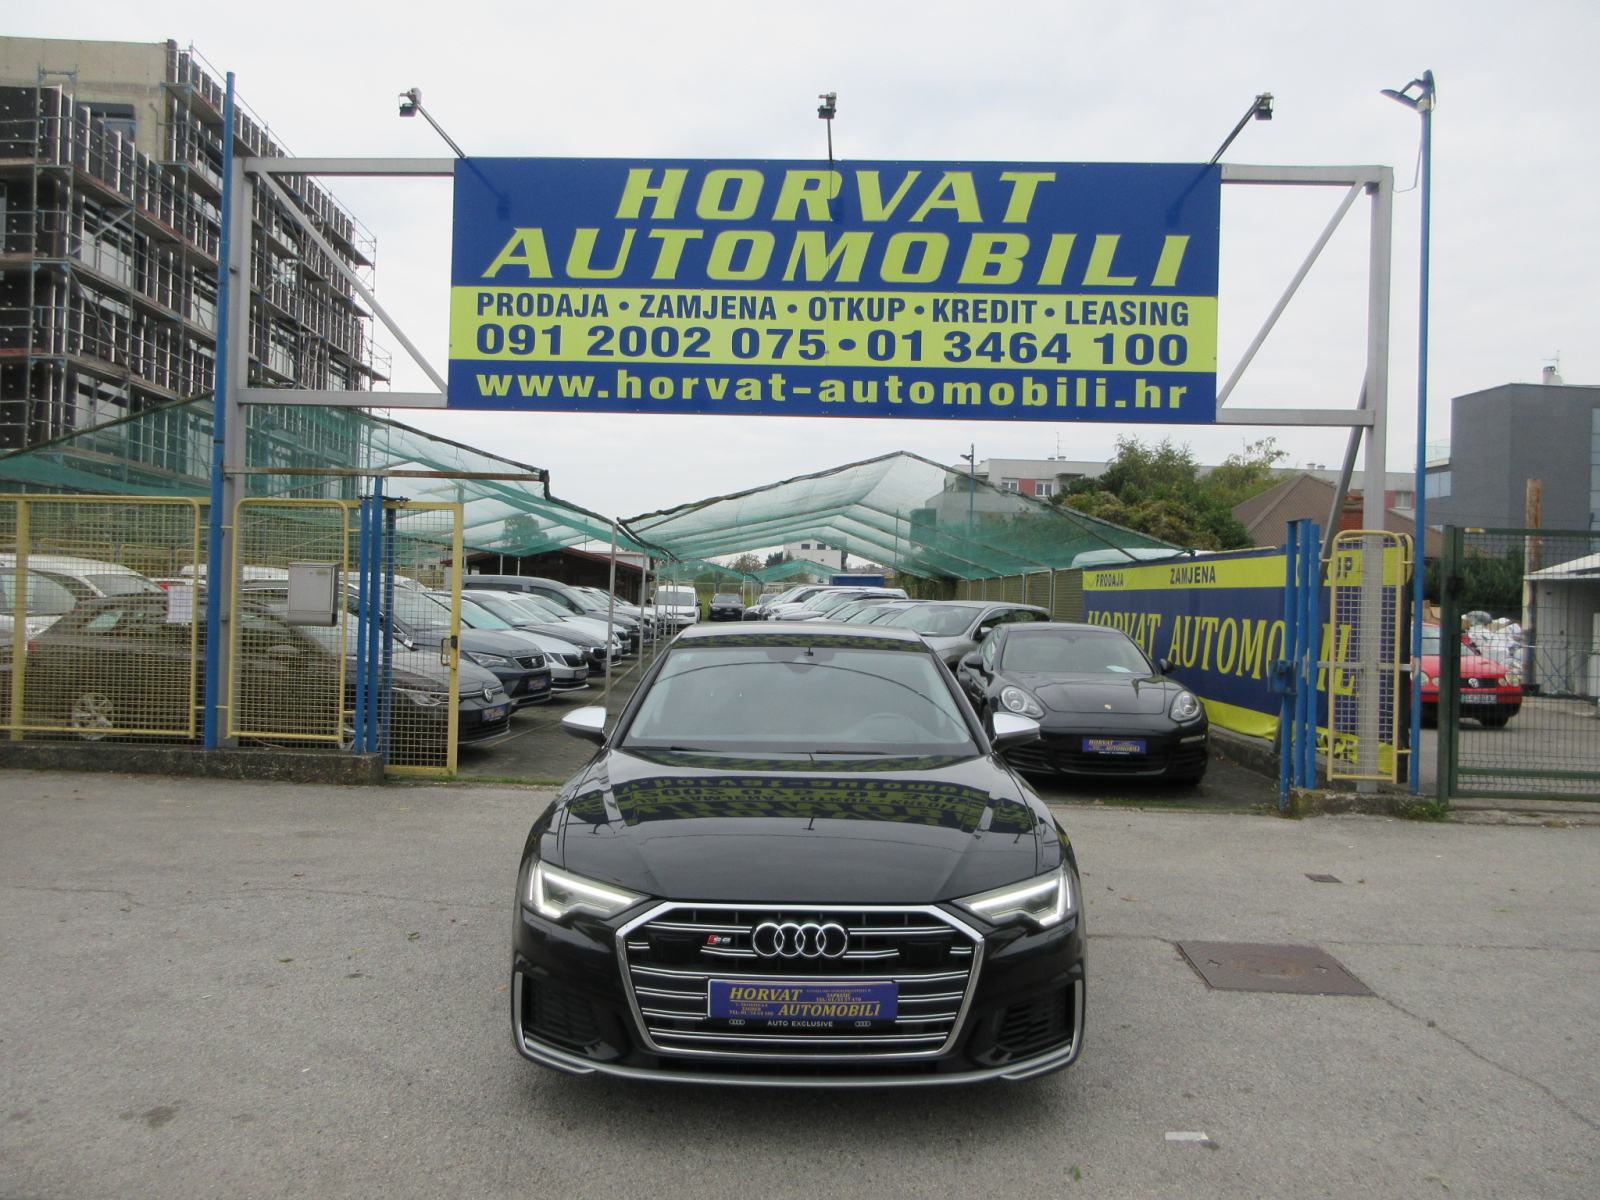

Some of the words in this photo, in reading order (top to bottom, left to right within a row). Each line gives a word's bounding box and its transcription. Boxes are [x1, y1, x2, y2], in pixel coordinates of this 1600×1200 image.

[615, 168, 1056, 223] HORVAT
[481, 228, 1190, 286] AUTOMOBILI
[477, 292, 609, 317] PRODAJA
[639, 294, 777, 320] ZAMJENA
[808, 296, 906, 321] OTKUP
[932, 298, 1037, 323] KREDIT
[1065, 300, 1189, 326] LEASING
[476, 323, 562, 355] 091
[587, 325, 711, 358] 2002
[731, 327, 827, 360] 075
[867, 329, 923, 362] 01
[943, 331, 1071, 364] 3464
[1094, 333, 1188, 366] 100
[476, 369, 1187, 408] www.horvat-automobili.hr
[1095, 573, 1124, 588] PRODAJA
[1169, 565, 1217, 585] ZAMJENA
[729, 987, 803, 1002] HORVAT
[777, 1003, 881, 1018] AUTOMOBILI
[767, 1020, 789, 1028] AUTO
[791, 1020, 833, 1028] EXCLUSIVE
